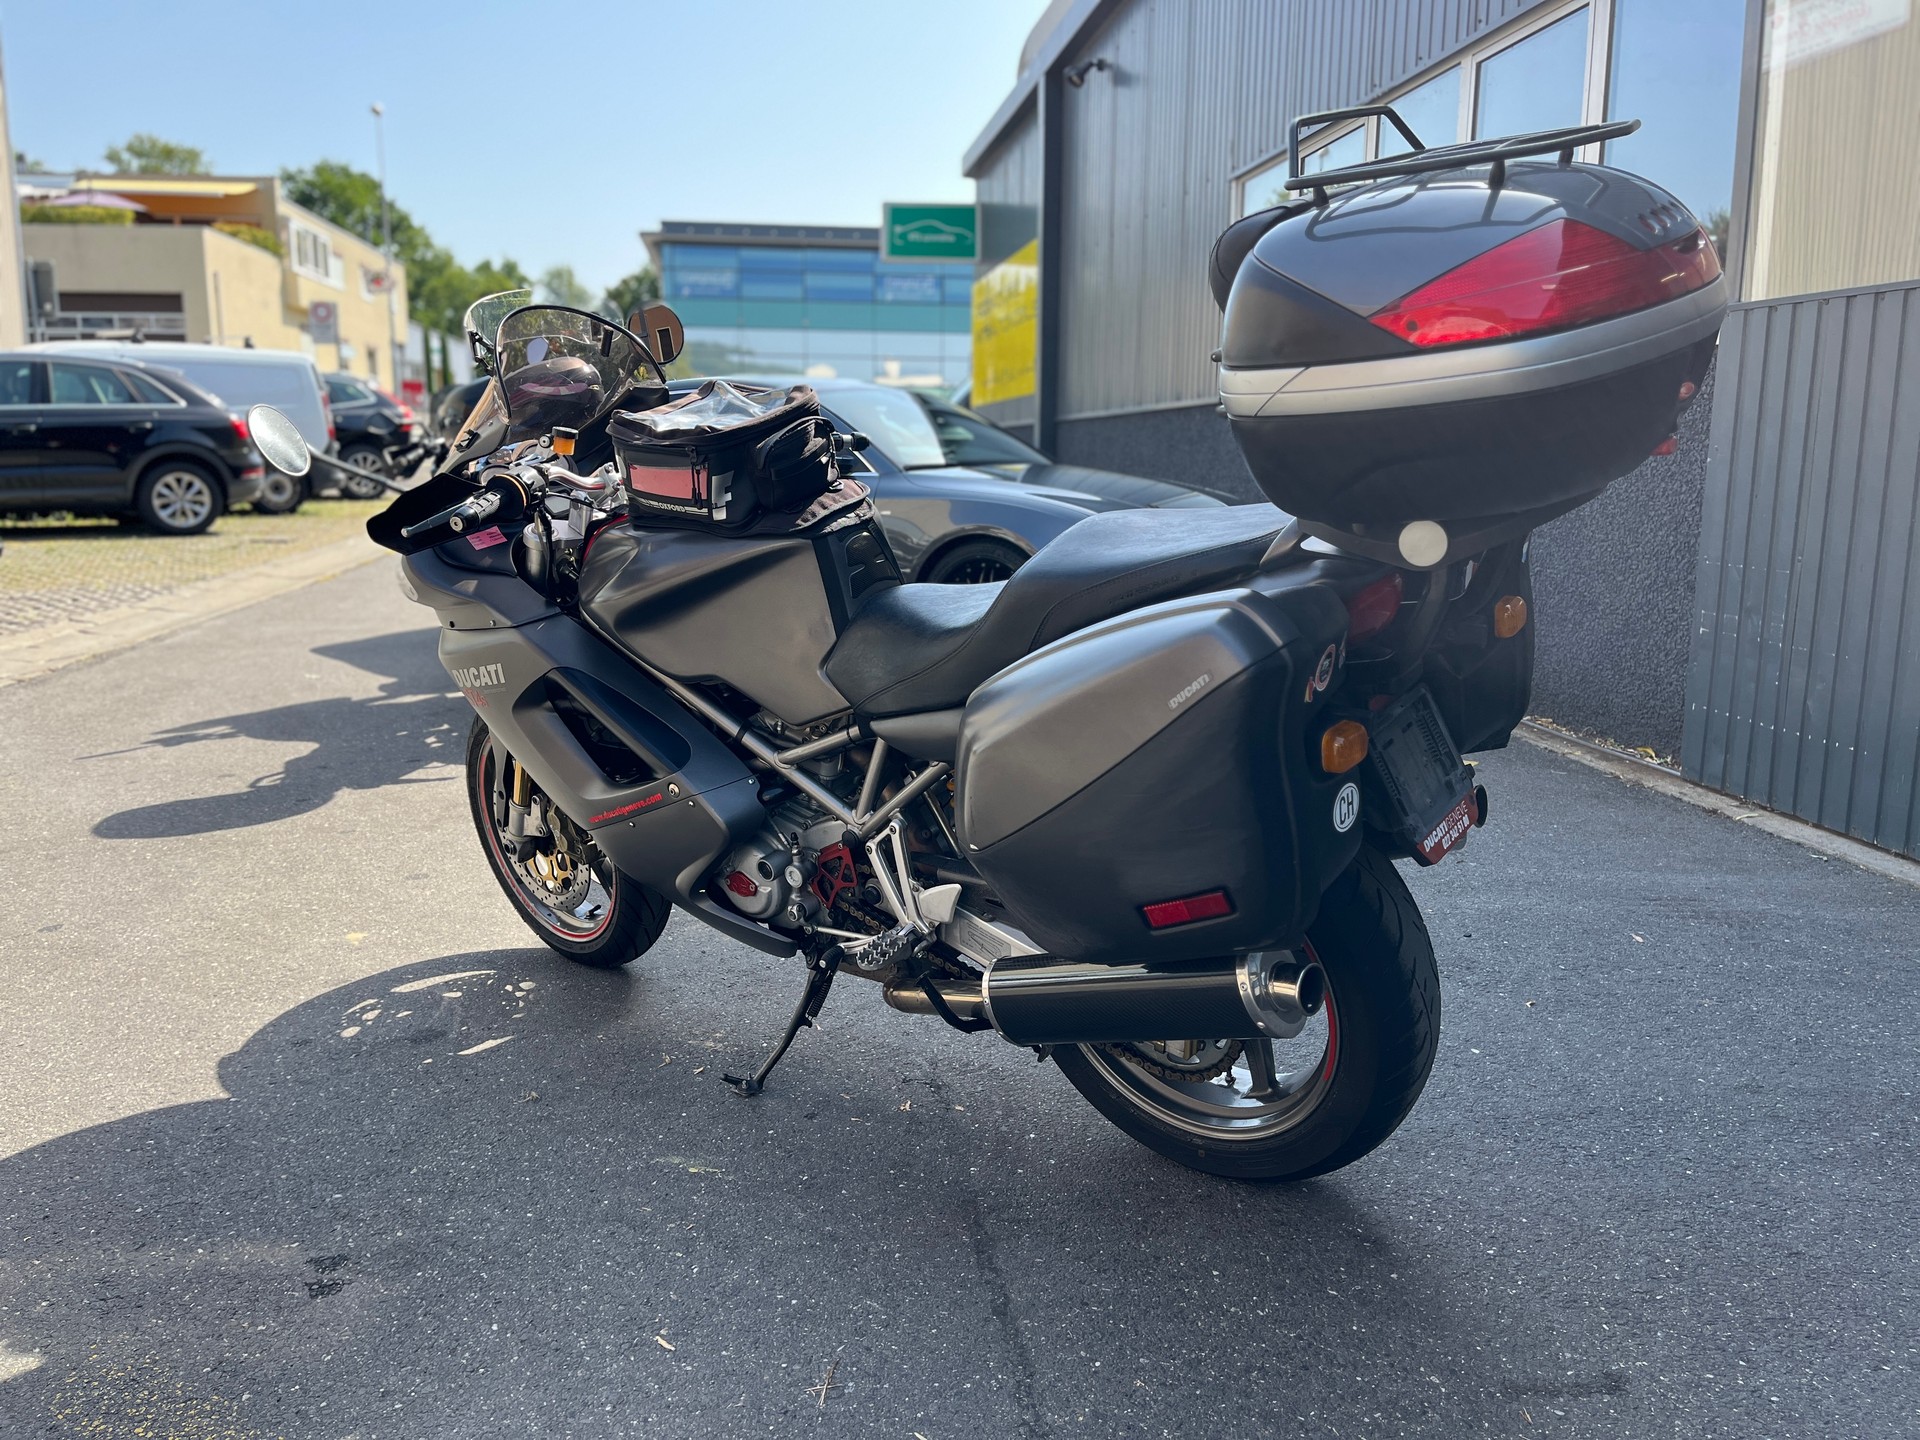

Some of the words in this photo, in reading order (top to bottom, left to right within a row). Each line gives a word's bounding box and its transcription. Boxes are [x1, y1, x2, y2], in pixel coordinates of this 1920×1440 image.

[659, 502, 686, 512] OXFORD
[452, 663, 505, 688] DUCATI
[1169, 674, 1209, 709] DUCATI
[1340, 789, 1354, 825] CH
